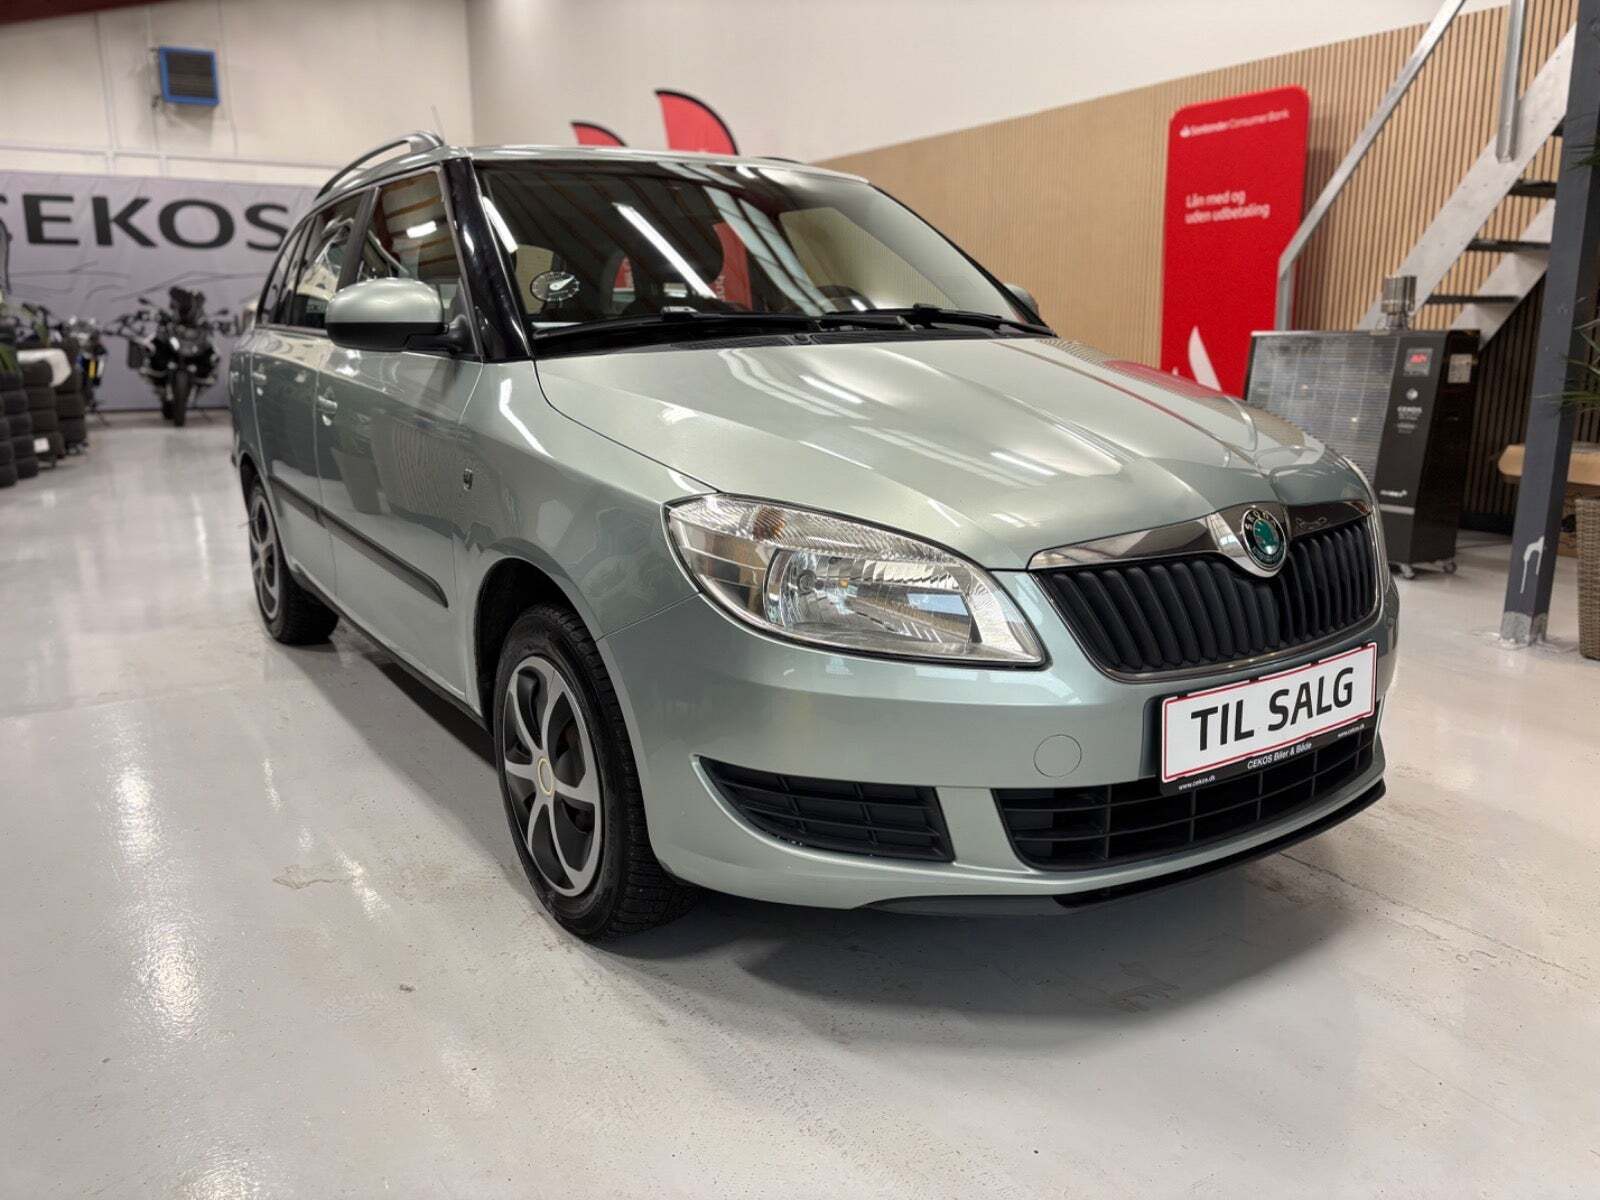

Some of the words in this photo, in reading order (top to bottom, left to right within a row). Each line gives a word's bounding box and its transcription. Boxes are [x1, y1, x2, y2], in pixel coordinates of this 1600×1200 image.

[0, 193, 290, 251] EKOS
[1191, 699, 1255, 751] TIL
[1267, 667, 1354, 731] SALG
[1247, 754, 1273, 769] CEKOS
[1274, 749, 1289, 761] Biler
